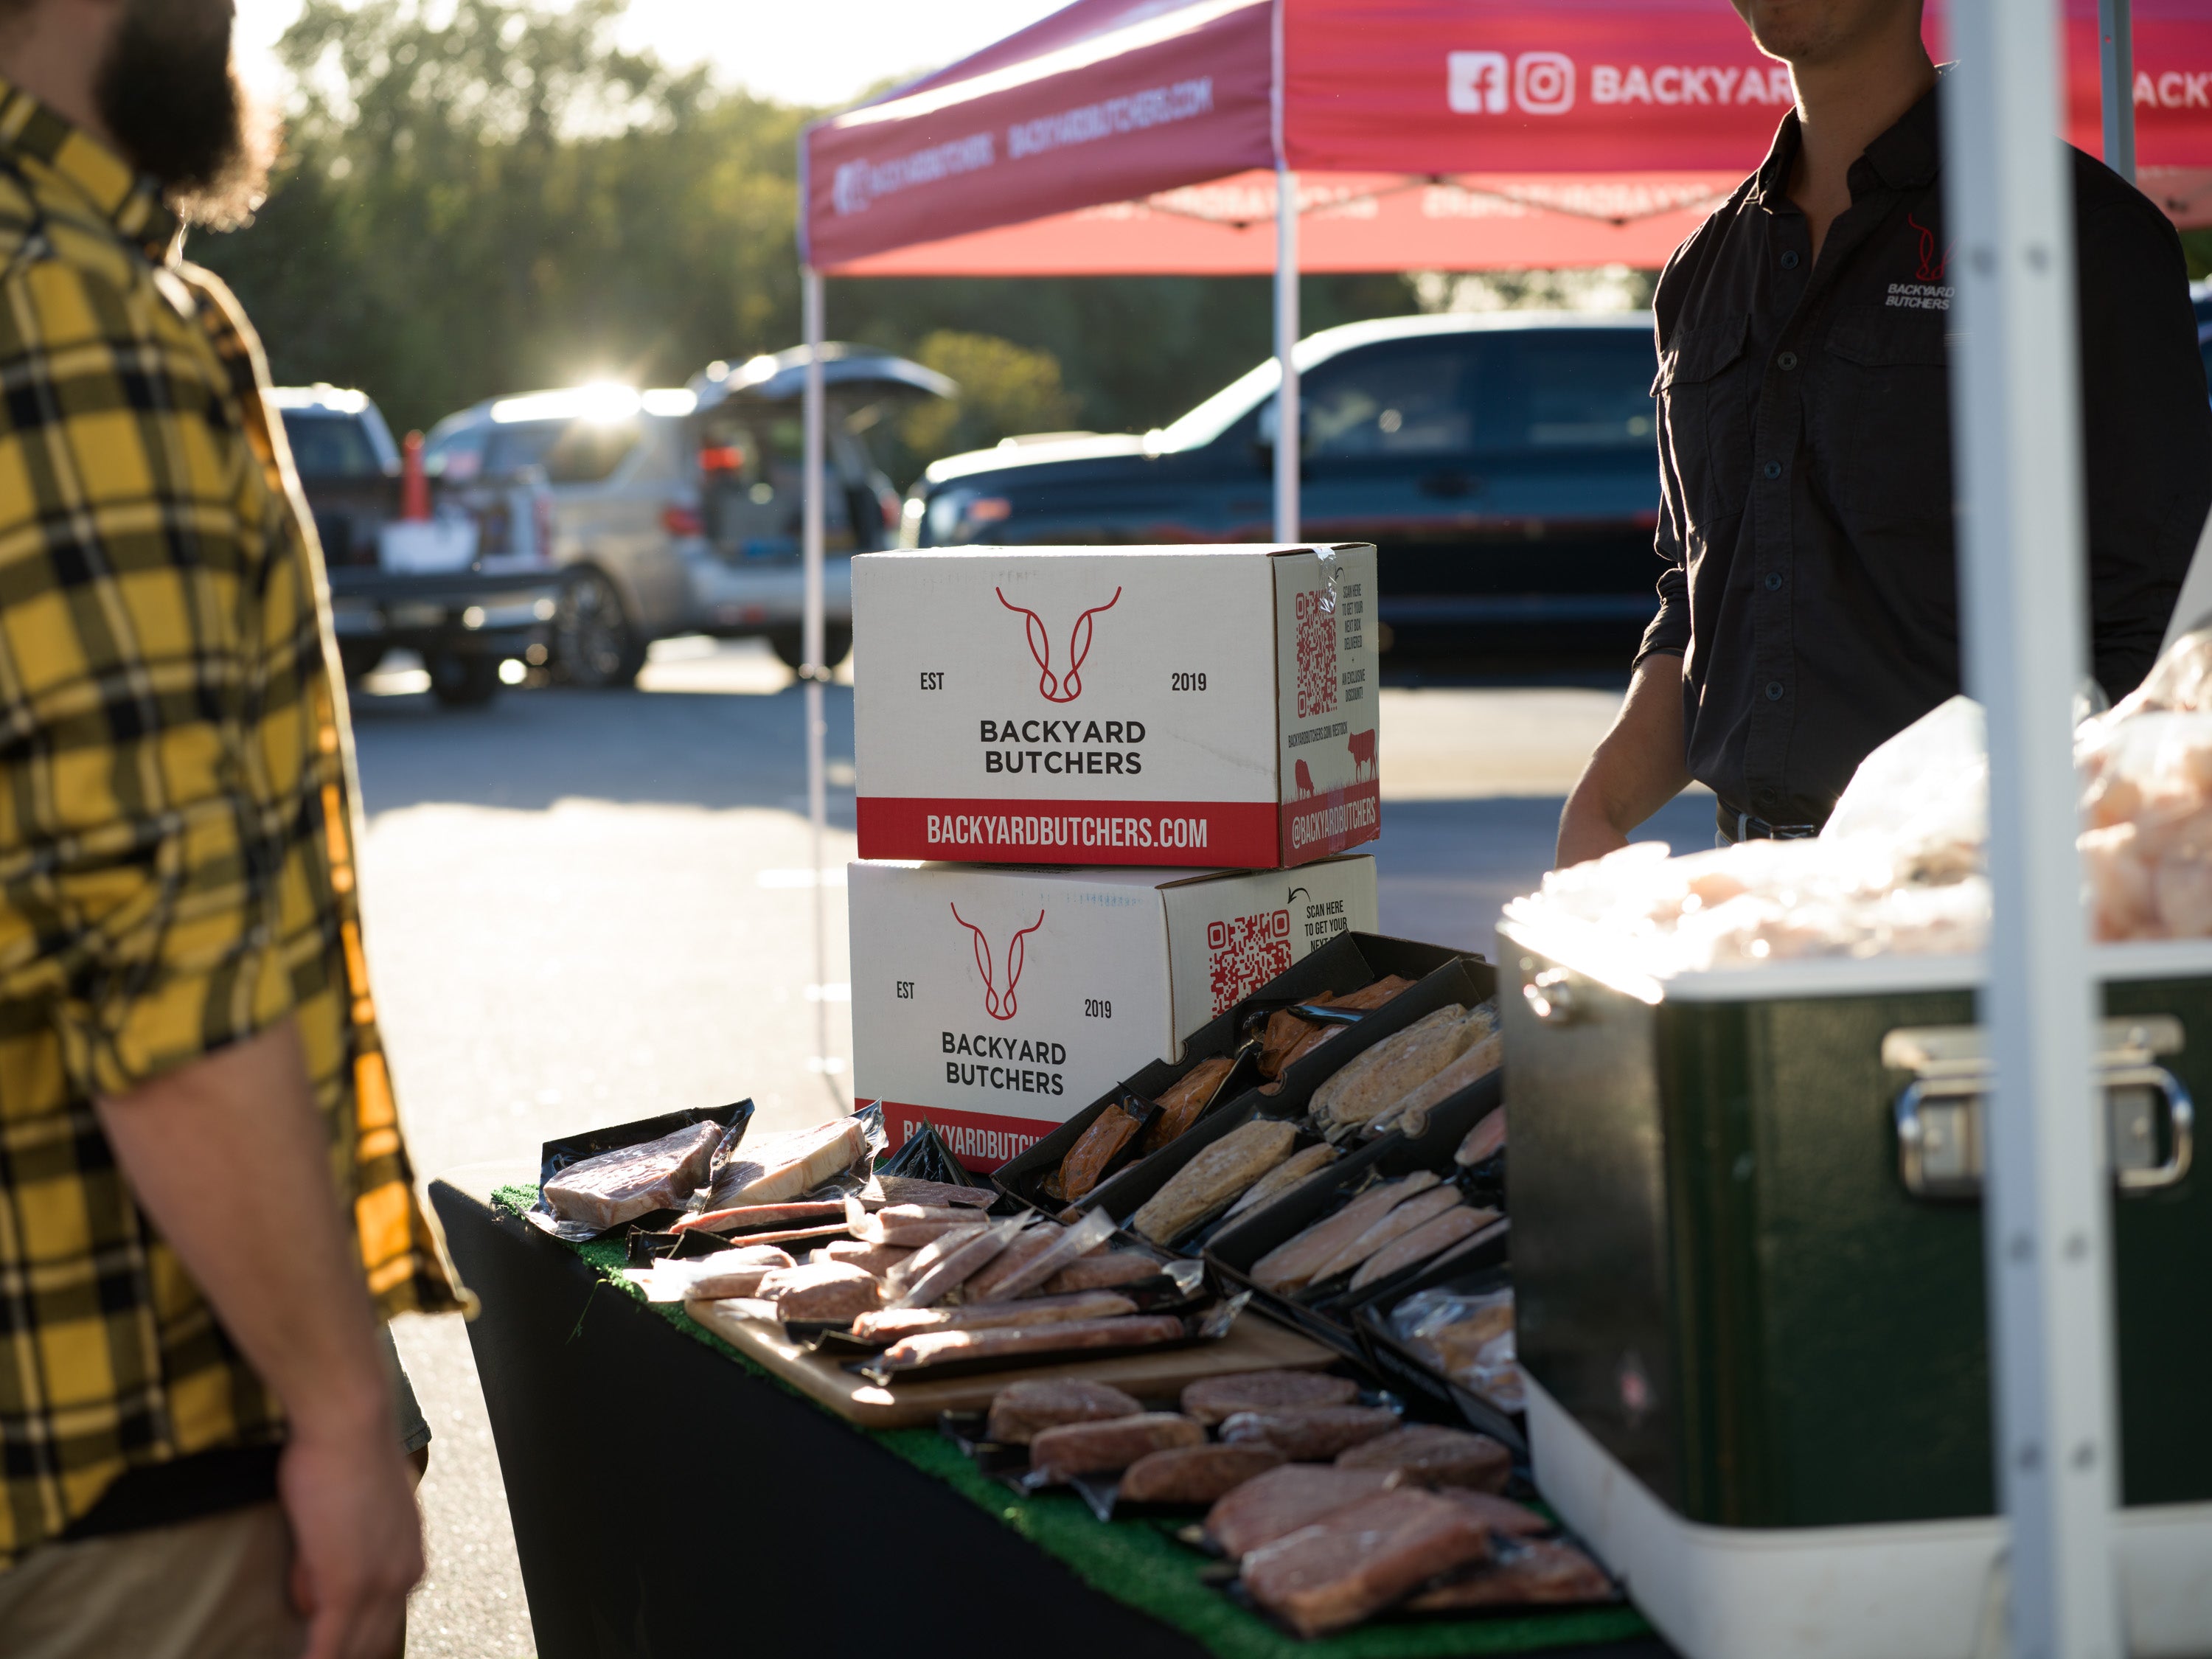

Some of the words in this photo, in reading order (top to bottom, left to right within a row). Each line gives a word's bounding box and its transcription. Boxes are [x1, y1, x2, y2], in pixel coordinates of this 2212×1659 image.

[1590, 64, 1793, 105] BACKYAR
[2133, 71, 2212, 108] ACK
[1888, 283, 1955, 298] BACKYARD
[1885, 295, 1950, 310] BUTCHERS
[1344, 635, 1363, 650] DELIVERED
[920, 672, 945, 690] EST
[1171, 672, 1207, 692] 2019
[980, 720, 1147, 744] BACKYARD
[985, 751, 1142, 775] BUTCHERS
[927, 815, 1208, 848] BACKYARDBUTCHERS.COM
[1292, 796, 1377, 849] @BACKYARDBUTCHERS
[1307, 903, 1325, 919] SCAN
[1326, 900, 1343, 915] HERE
[1304, 922, 1314, 936] TO
[1315, 920, 1328, 935] GET
[1329, 917, 1347, 931] YOUR
[897, 981, 914, 999] EST
[1085, 998, 1112, 1019] 2019
[942, 1032, 1066, 1065] BACKYARD
[946, 1062, 1064, 1096] BUTCHERS
[903, 1120, 1043, 1161] BKYARDBUTC
